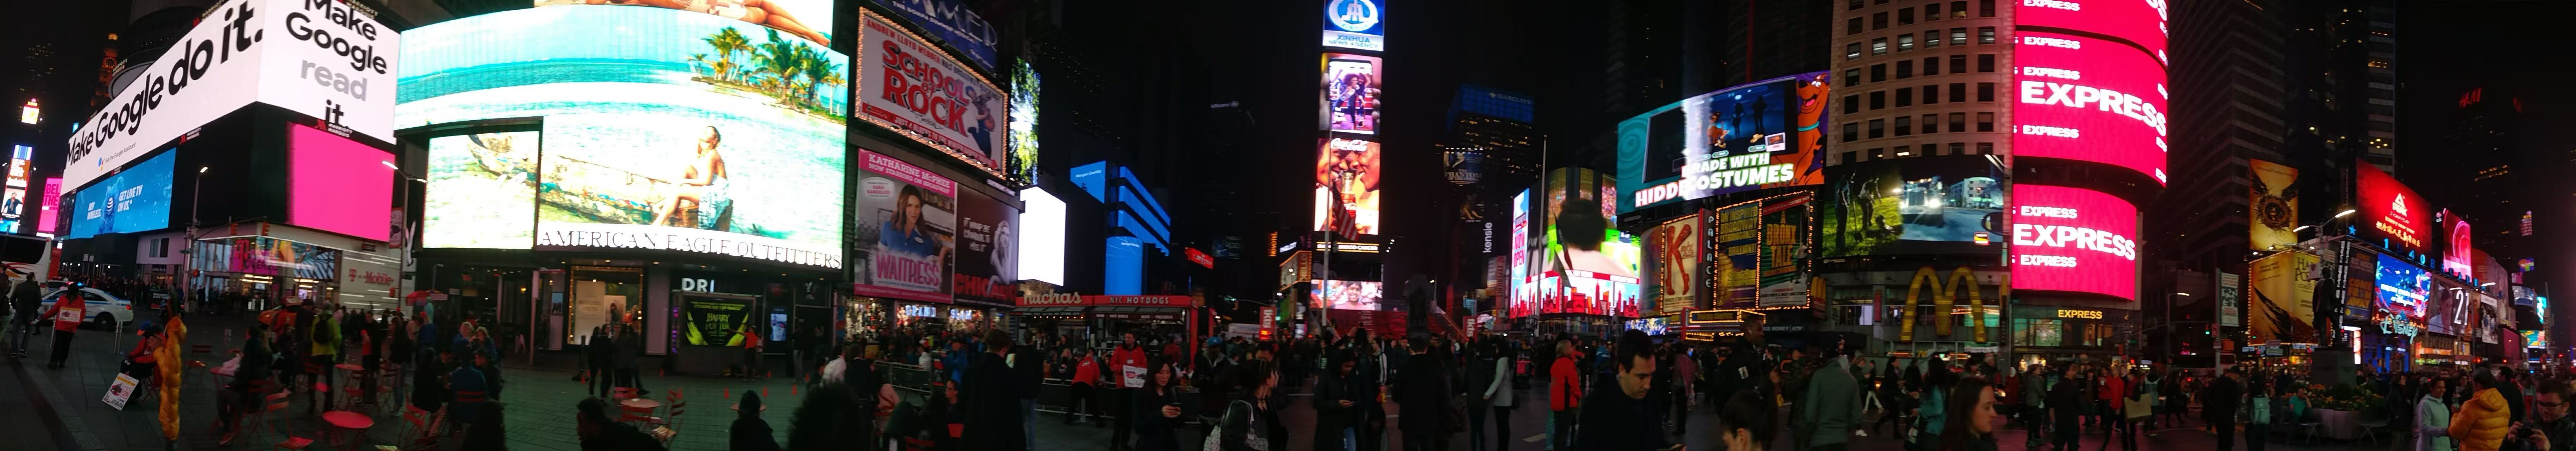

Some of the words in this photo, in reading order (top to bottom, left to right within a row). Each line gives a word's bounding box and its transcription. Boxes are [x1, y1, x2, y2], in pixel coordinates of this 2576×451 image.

[2024, 0, 2080, 11] EXPRESS
[303, 0, 376, 41] Make
[866, 19, 895, 39] ANDREW
[286, 12, 387, 74] Google
[1336, 34, 1371, 43] XINHUA
[2024, 36, 2081, 50] EXPRESS
[301, 59, 368, 102] read
[882, 39, 970, 105] SCHOOL
[2023, 67, 2080, 80] EXPRESS
[66, 130, 93, 166] Make
[95, 73, 164, 148] Google
[168, 39, 213, 96] do
[220, 1, 264, 64] it.
[882, 67, 968, 138] ROCK
[2021, 80, 2167, 137] EXPRESS
[2022, 125, 2080, 139] EXPRESS
[869, 154, 920, 177] KATHARINE
[1729, 152, 1770, 169] WITH
[869, 163, 884, 172] NOW
[885, 168, 913, 181] STARRING
[923, 180, 950, 194] BROADWAY
[44, 195, 59, 206] THE
[2021, 205, 2078, 219] EXPRESS
[1720, 216, 1758, 234] BROADWAY
[1766, 223, 1797, 245] BRONX
[1482, 222, 1493, 253] kensie
[2013, 223, 2136, 261] EXPRESS
[541, 230, 658, 249] AMERICAN
[667, 234, 731, 255] EAGLE
[737, 242, 842, 269] OUTFITTERS
[1705, 216, 1715, 288] PALACE
[1770, 245, 1794, 268] TALE
[876, 253, 940, 287] WAITRESS
[2020, 254, 2077, 268] EXPRESS
[682, 278, 714, 293] DRI
[954, 273, 1017, 301] CHICAGO
[1024, 288, 1082, 305] nuchas
[2057, 309, 2103, 319] EXPRESS
[1467, 318, 1476, 337] tkts
